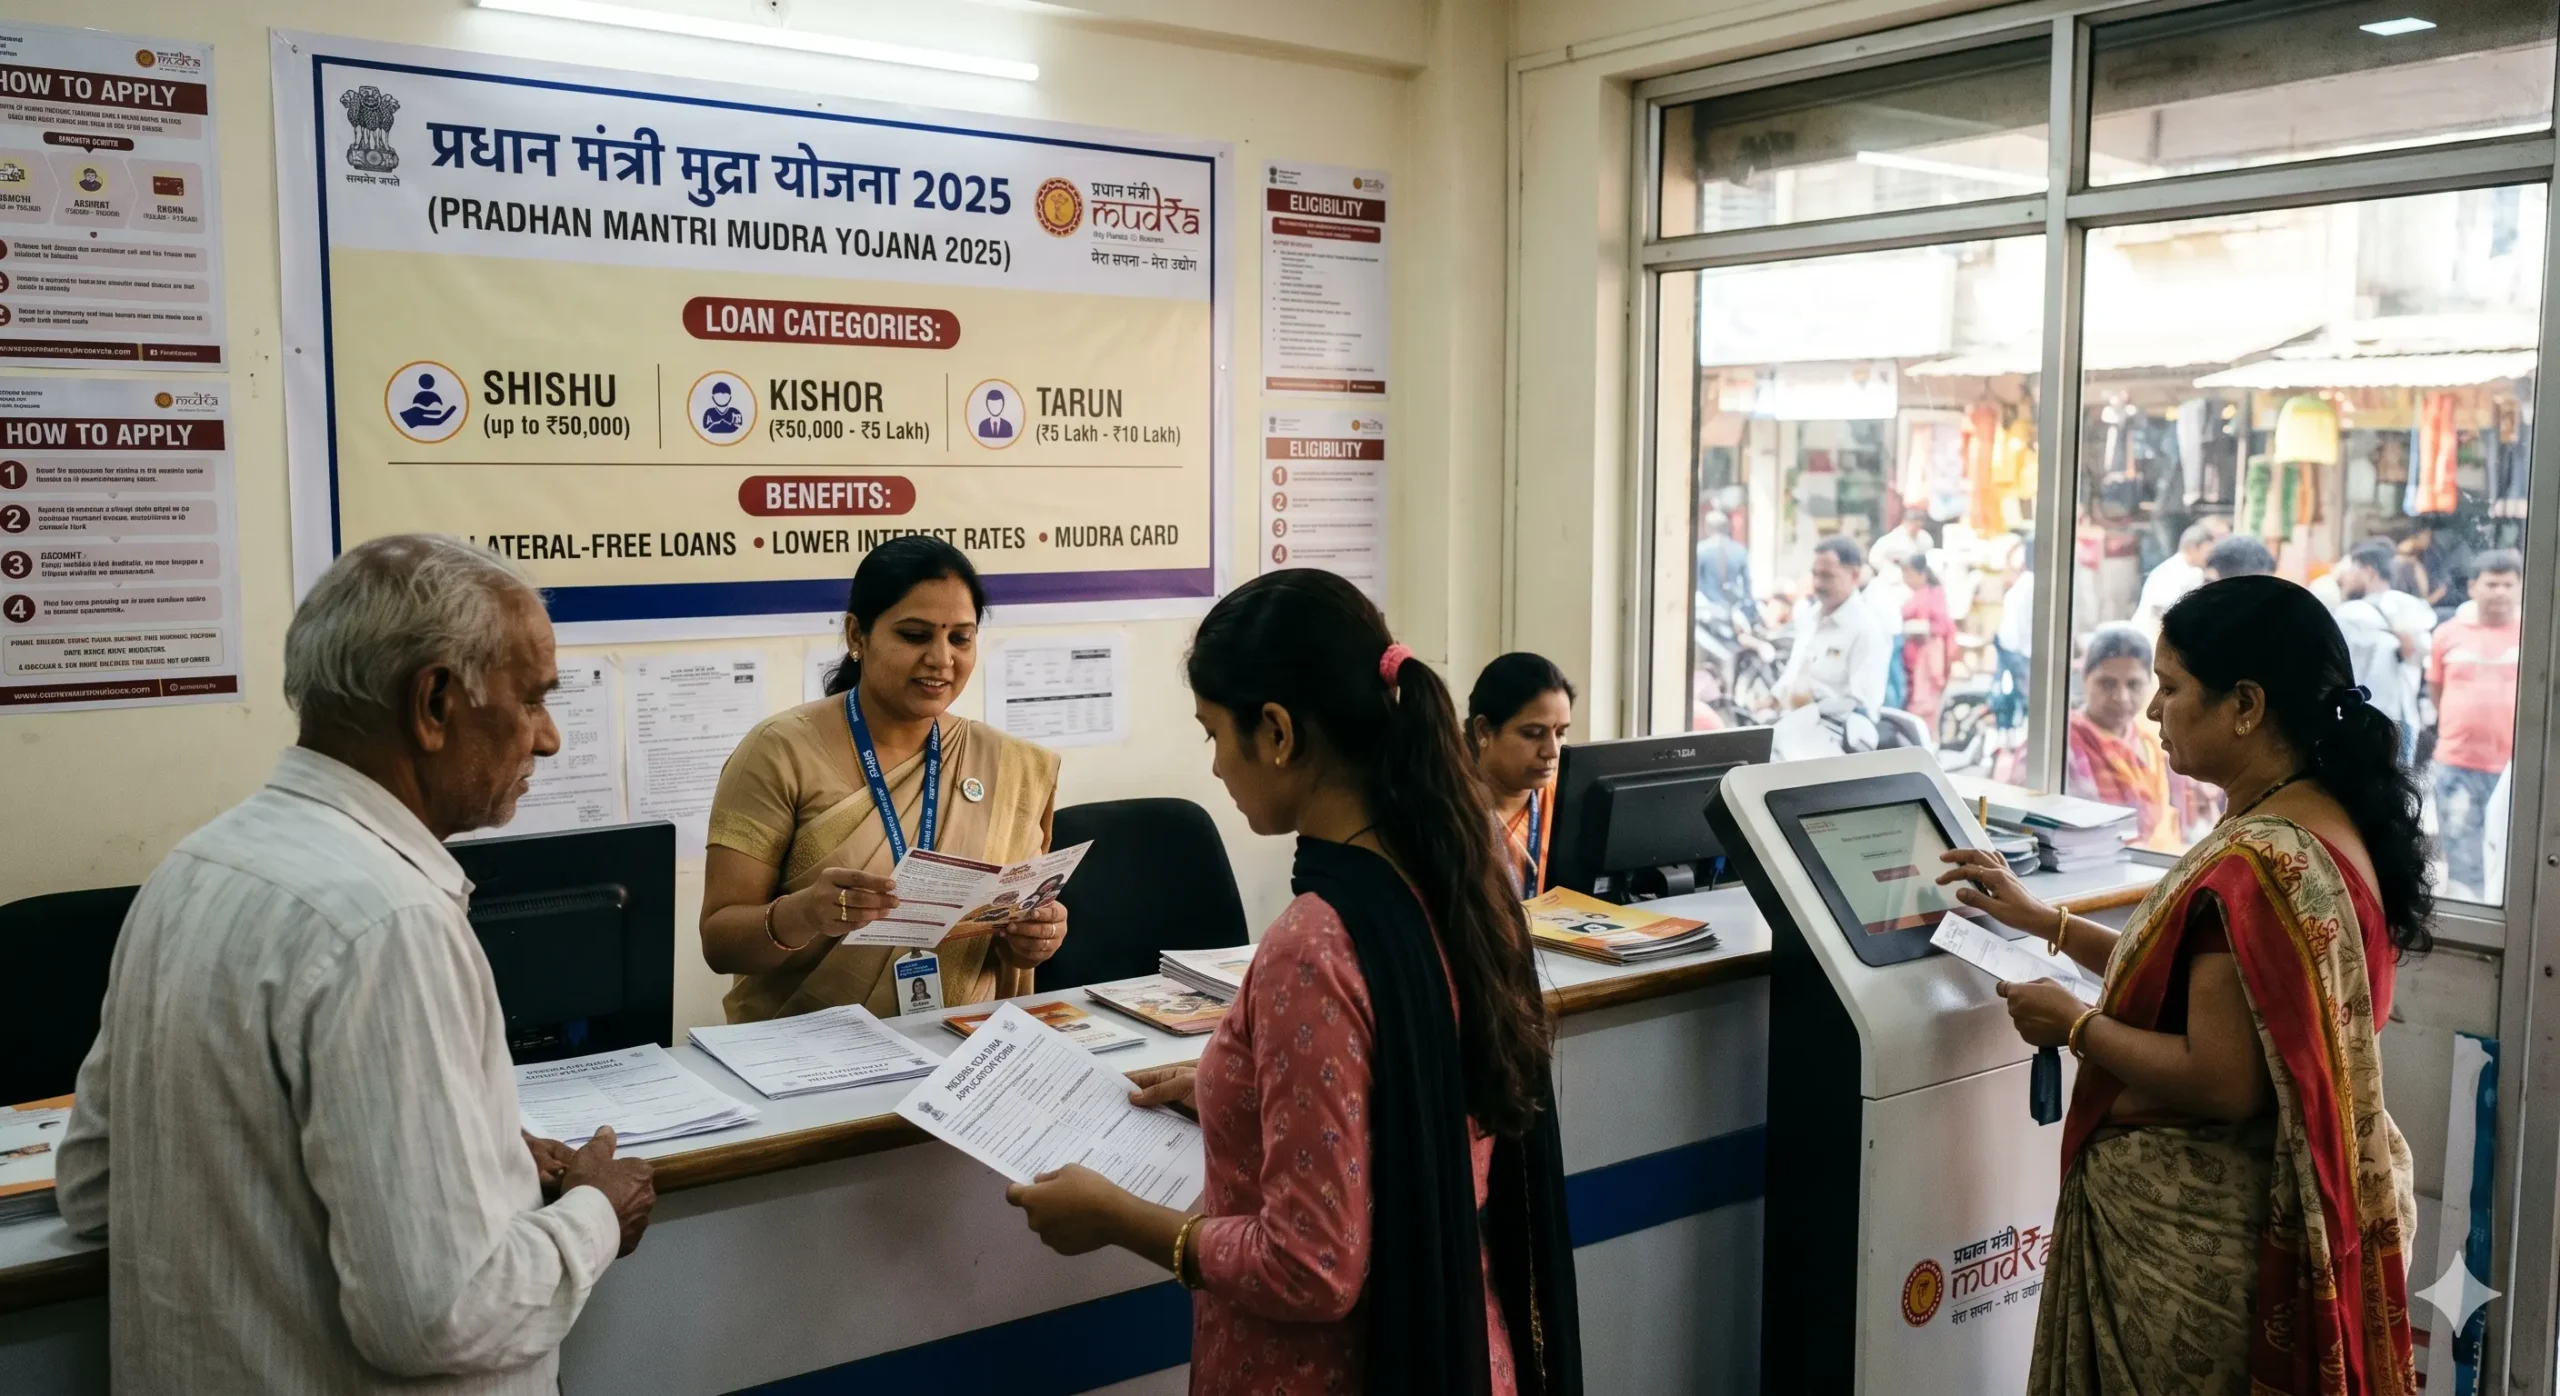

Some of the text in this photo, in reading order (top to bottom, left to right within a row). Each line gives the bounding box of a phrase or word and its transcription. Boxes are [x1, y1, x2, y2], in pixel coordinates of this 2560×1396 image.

[59, 75, 92, 99] TO
[101, 80, 177, 107] APPLY
[427, 122, 1011, 215] प्रधान मंत्री मुद्रा योजना 2025
[1091, 182, 1150, 200] प्रधान मंत्री
[1290, 194, 1363, 217] ELIGIBILITY
[428, 195, 1011, 273] (PRADHAN MANTRI MUDRA YOJANA 2025)
[1091, 248, 1110, 265] मेरा
[1112, 254, 1140, 267] सपना
[1151, 253, 1168, 269] मेरा
[706, 304, 941, 342] LOAN CATEGORIES:
[483, 370, 616, 407] SHISHU
[769, 379, 884, 413] KISHOR
[1037, 387, 1122, 417] TARUN
[6, 422, 193, 447] HOW TO APPLY
[483, 414, 630, 440] (up to ₹50,000)
[769, 419, 844, 442] (₹50,000
[861, 421, 881, 440] ₹5
[886, 421, 930, 443] Lakh)
[1036, 424, 1060, 445] (₹5
[1065, 424, 1098, 443] Lakh
[1113, 425, 1139, 443] ₹10
[1143, 425, 1181, 447] Lakh)
[1290, 440, 1363, 458] ELIGIBILITY
[4, 465, 16, 485] 1
[1276, 469, 1283, 483] 1
[766, 481, 891, 510] BENEFITS:
[1275, 494, 1284, 509] 2
[6, 509, 22, 529] 2
[1276, 521, 1283, 535] 3
[470, 532, 736, 559] ATERAL-FREE LOANS
[773, 529, 849, 554] LOWER
[964, 527, 1026, 550] RATES
[1055, 525, 1178, 548] MUDRA CARD
[9, 555, 24, 574] 3
[1275, 546, 1283, 561] 4
[11, 599, 27, 618] 4
